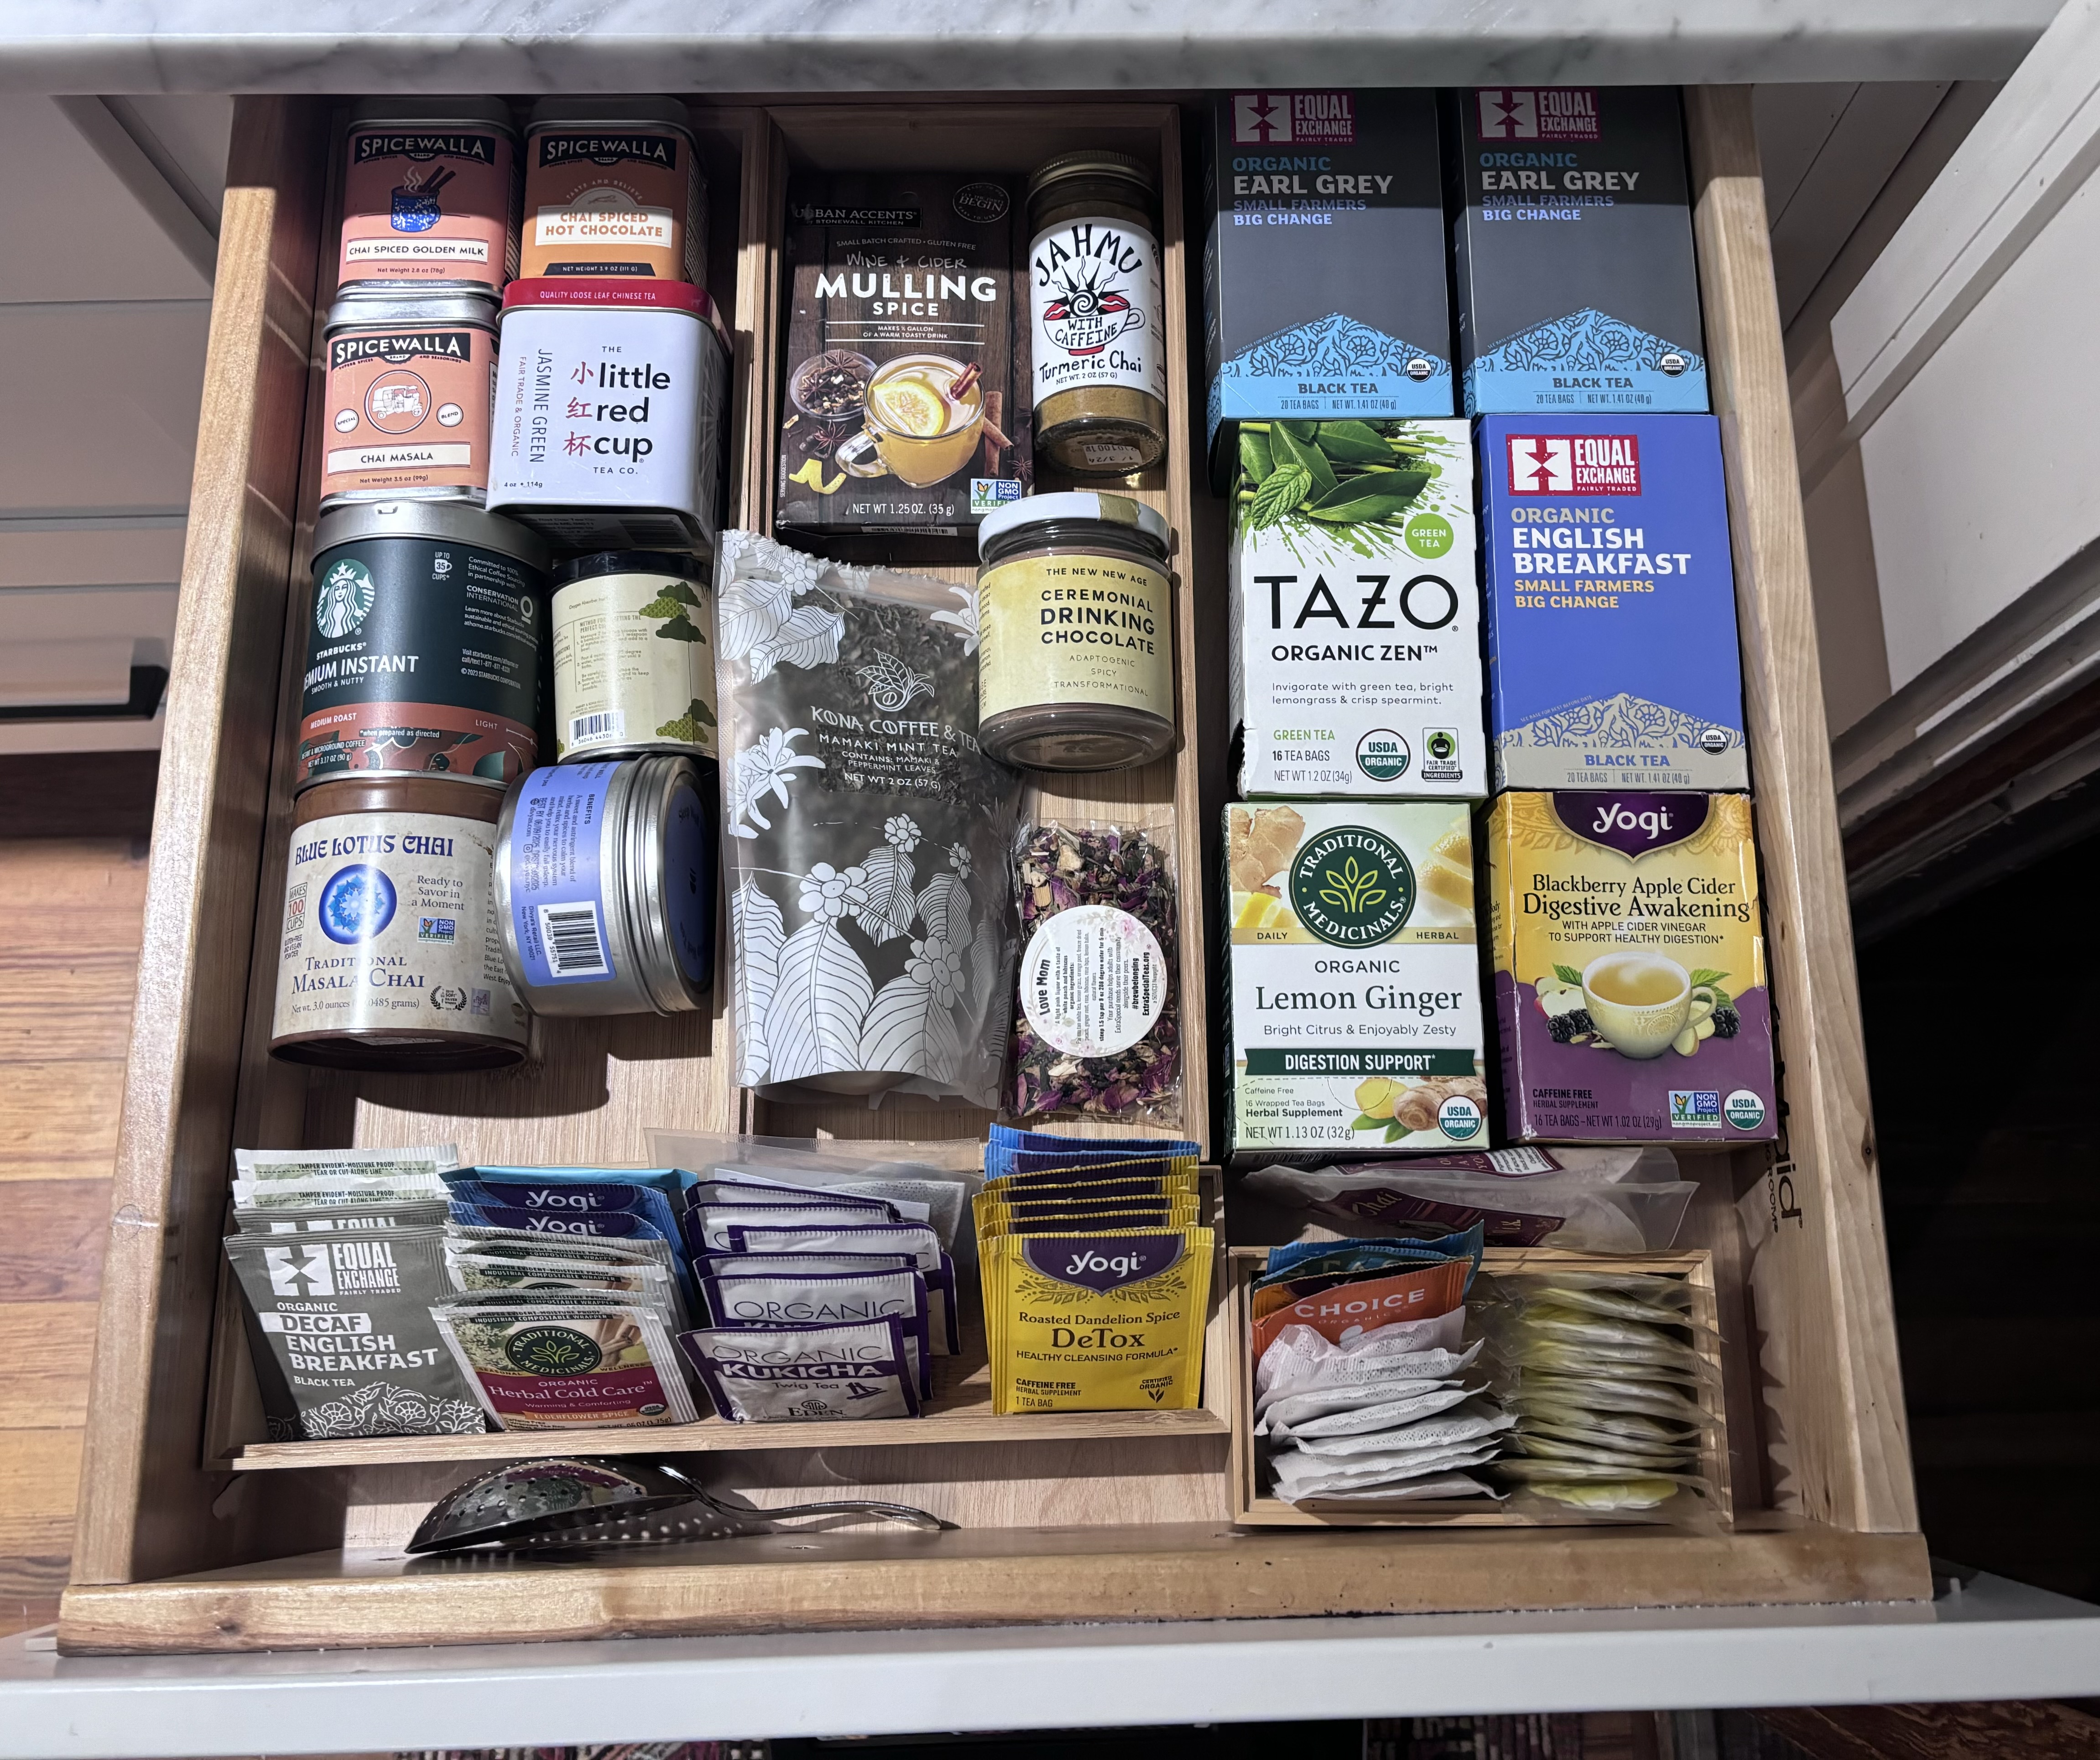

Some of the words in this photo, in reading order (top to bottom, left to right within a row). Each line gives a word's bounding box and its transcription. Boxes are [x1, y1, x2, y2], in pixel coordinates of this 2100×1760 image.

[1294, 95, 1352, 119] EQUAL
[1296, 120, 1352, 135] EXCHANGE
[361, 137, 485, 158] SPICEWALLA
[547, 139, 667, 161] SPICEWALLA
[1233, 157, 1331, 172] ORGANIC
[1234, 176, 1308, 195] EARL
[1316, 175, 1393, 194] GREY
[1482, 171, 1555, 190] EARL
[1563, 171, 1639, 190] GREY
[560, 212, 593, 223] CHAI
[597, 212, 649, 223] SPICED
[546, 224, 575, 236] HOT
[579, 224, 662, 237] CHOCOLATE
[349, 246, 372, 255] CHAI
[374, 245, 409, 255] SPICED
[413, 245, 455, 254] GOLDEN
[459, 247, 484, 256] MILK
[1036, 224, 1142, 287] JAHMU
[815, 273, 996, 302] MULLING
[873, 302, 939, 317] SPICE
[1068, 317, 1102, 332] WITH
[1055, 324, 1118, 346] CAFFEINE
[336, 336, 461, 364] SPICEWALLA
[570, 361, 594, 385] 小
[1039, 355, 1105, 383] Turmeric
[1110, 350, 1142, 374] Chai
[534, 349, 553, 411] JASMINE
[599, 364, 671, 390] little
[1553, 378, 1601, 388] BLACK
[1605, 378, 1633, 388] TEA
[1298, 383, 1345, 394] BLACK
[1353, 383, 1378, 394] TEA
[565, 396, 593, 419] 红
[597, 397, 649, 423] red
[529, 416, 548, 463] GREEN
[562, 431, 592, 457] 杯
[361, 453, 386, 463] CHAI
[390, 452, 433, 462] MASALA
[1575, 439, 1635, 466] EQUAL
[1576, 468, 1636, 484] EXCHANGE
[1511, 508, 1615, 523] ORGANIC
[1412, 528, 1446, 537] GREEN
[1513, 528, 1643, 549] ENGLISH
[1513, 553, 1691, 574] BREAKFAST
[1072, 568, 1097, 577] NEW
[1102, 570, 1126, 581] NEW
[1130, 576, 1148, 587] AGE
[466, 592, 519, 612] INTERNATIONAL
[467, 585, 519, 605] CONSERVATION
[1041, 589, 1153, 614] CEREMONIAL
[1041, 607, 1155, 635] DRINKING
[1041, 631, 1155, 656] CHOCOLATE
[1271, 645, 1374, 661] ORGANIC
[340, 656, 419, 677] INSTANT
[1070, 655, 1135, 667] ADAPTOGENIC
[1091, 667, 1116, 677] SPICY
[311, 682, 332, 695] SMOOTH
[340, 676, 364, 687] NUTTY
[1054, 680, 1148, 697] TRANSFORMATIONAL
[1272, 682, 1328, 693] Invigorate
[1333, 682, 1356, 691] with
[1360, 683, 1391, 693] green
[1395, 683, 1416, 692] tea,
[1420, 682, 1454, 693] bright
[1272, 695, 1336, 705] lemongrass
[1340, 696, 1348, 704] &
[1351, 696, 1377, 705] crisp
[1381, 696, 1441, 705] spearmint.
[310, 717, 332, 729] MEDIUM
[333, 713, 357, 726] ROAST
[1274, 730, 1311, 740] GREEN
[1314, 730, 1335, 740] TEA
[819, 734, 879, 750] MAMAKI
[886, 740, 926, 752] MINT
[933, 745, 958, 757] TEA
[1369, 742, 1397, 753] USDA
[1272, 751, 1282, 760] 16
[1284, 750, 1303, 760] TEA
[1305, 750, 1329, 761] BAGS
[1365, 757, 1402, 767] ORGANIC
[1585, 755, 1636, 767] BLACK
[1640, 755, 1670, 766] TEA
[584, 794, 595, 824] BENEFITS
[295, 839, 328, 866] BLUE
[331, 836, 396, 856] LOTUS
[401, 836, 453, 857] CHAI
[1299, 834, 1404, 879] TRADITIONAL
[417, 875, 447, 888] Ready
[450, 877, 463, 887] to
[1533, 874, 1626, 897] Blackberry
[1631, 877, 1683, 897] Apple
[1688, 878, 1735, 894] Cider
[418, 886, 448, 898] Savor
[450, 888, 460, 898] in
[289, 899, 304, 916] 100
[420, 897, 464, 911] Moment
[1524, 893, 1621, 920] Digestive
[1627, 896, 1750, 922] Awakening
[1563, 921, 1588, 930] WITH
[1591, 922, 1624, 931] APPLE
[1627, 922, 1658, 931] CIDER
[1661, 923, 1706, 932] VINEGAR
[1036, 959, 1051, 986] Mom
[1314, 960, 1400, 973] ORGANIC
[369, 968, 424, 987] CHAI
[1038, 989, 1051, 1016] Love
[1256, 986, 1356, 1010] Lemon
[1365, 985, 1462, 1017] Ginger
[1285, 1055, 1361, 1071] DIGESTION
[332, 1242, 396, 1270] EQUAL
[337, 1267, 400, 1290] EXCHANGE
[277, 1302, 338, 1312] ORGANIC
[1295, 1289, 1425, 1318] CHOICE
[280, 1315, 361, 1332] DECAF
[1019, 1312, 1071, 1324] Roasted
[1075, 1315, 1142, 1324] Dandelion
[1146, 1311, 1180, 1323] Spice
[286, 1335, 396, 1354] ENGLISH
[1052, 1328, 1145, 1348] DeTox
[288, 1349, 438, 1371] BREAKFAST
[712, 1345, 883, 1364] ORGANIC
[721, 1363, 882, 1379] KUKICHA
[294, 1376, 330, 1386] BLACK
[332, 1378, 355, 1386] TEA
[1016, 1378, 1053, 1388] CAFFEINE
